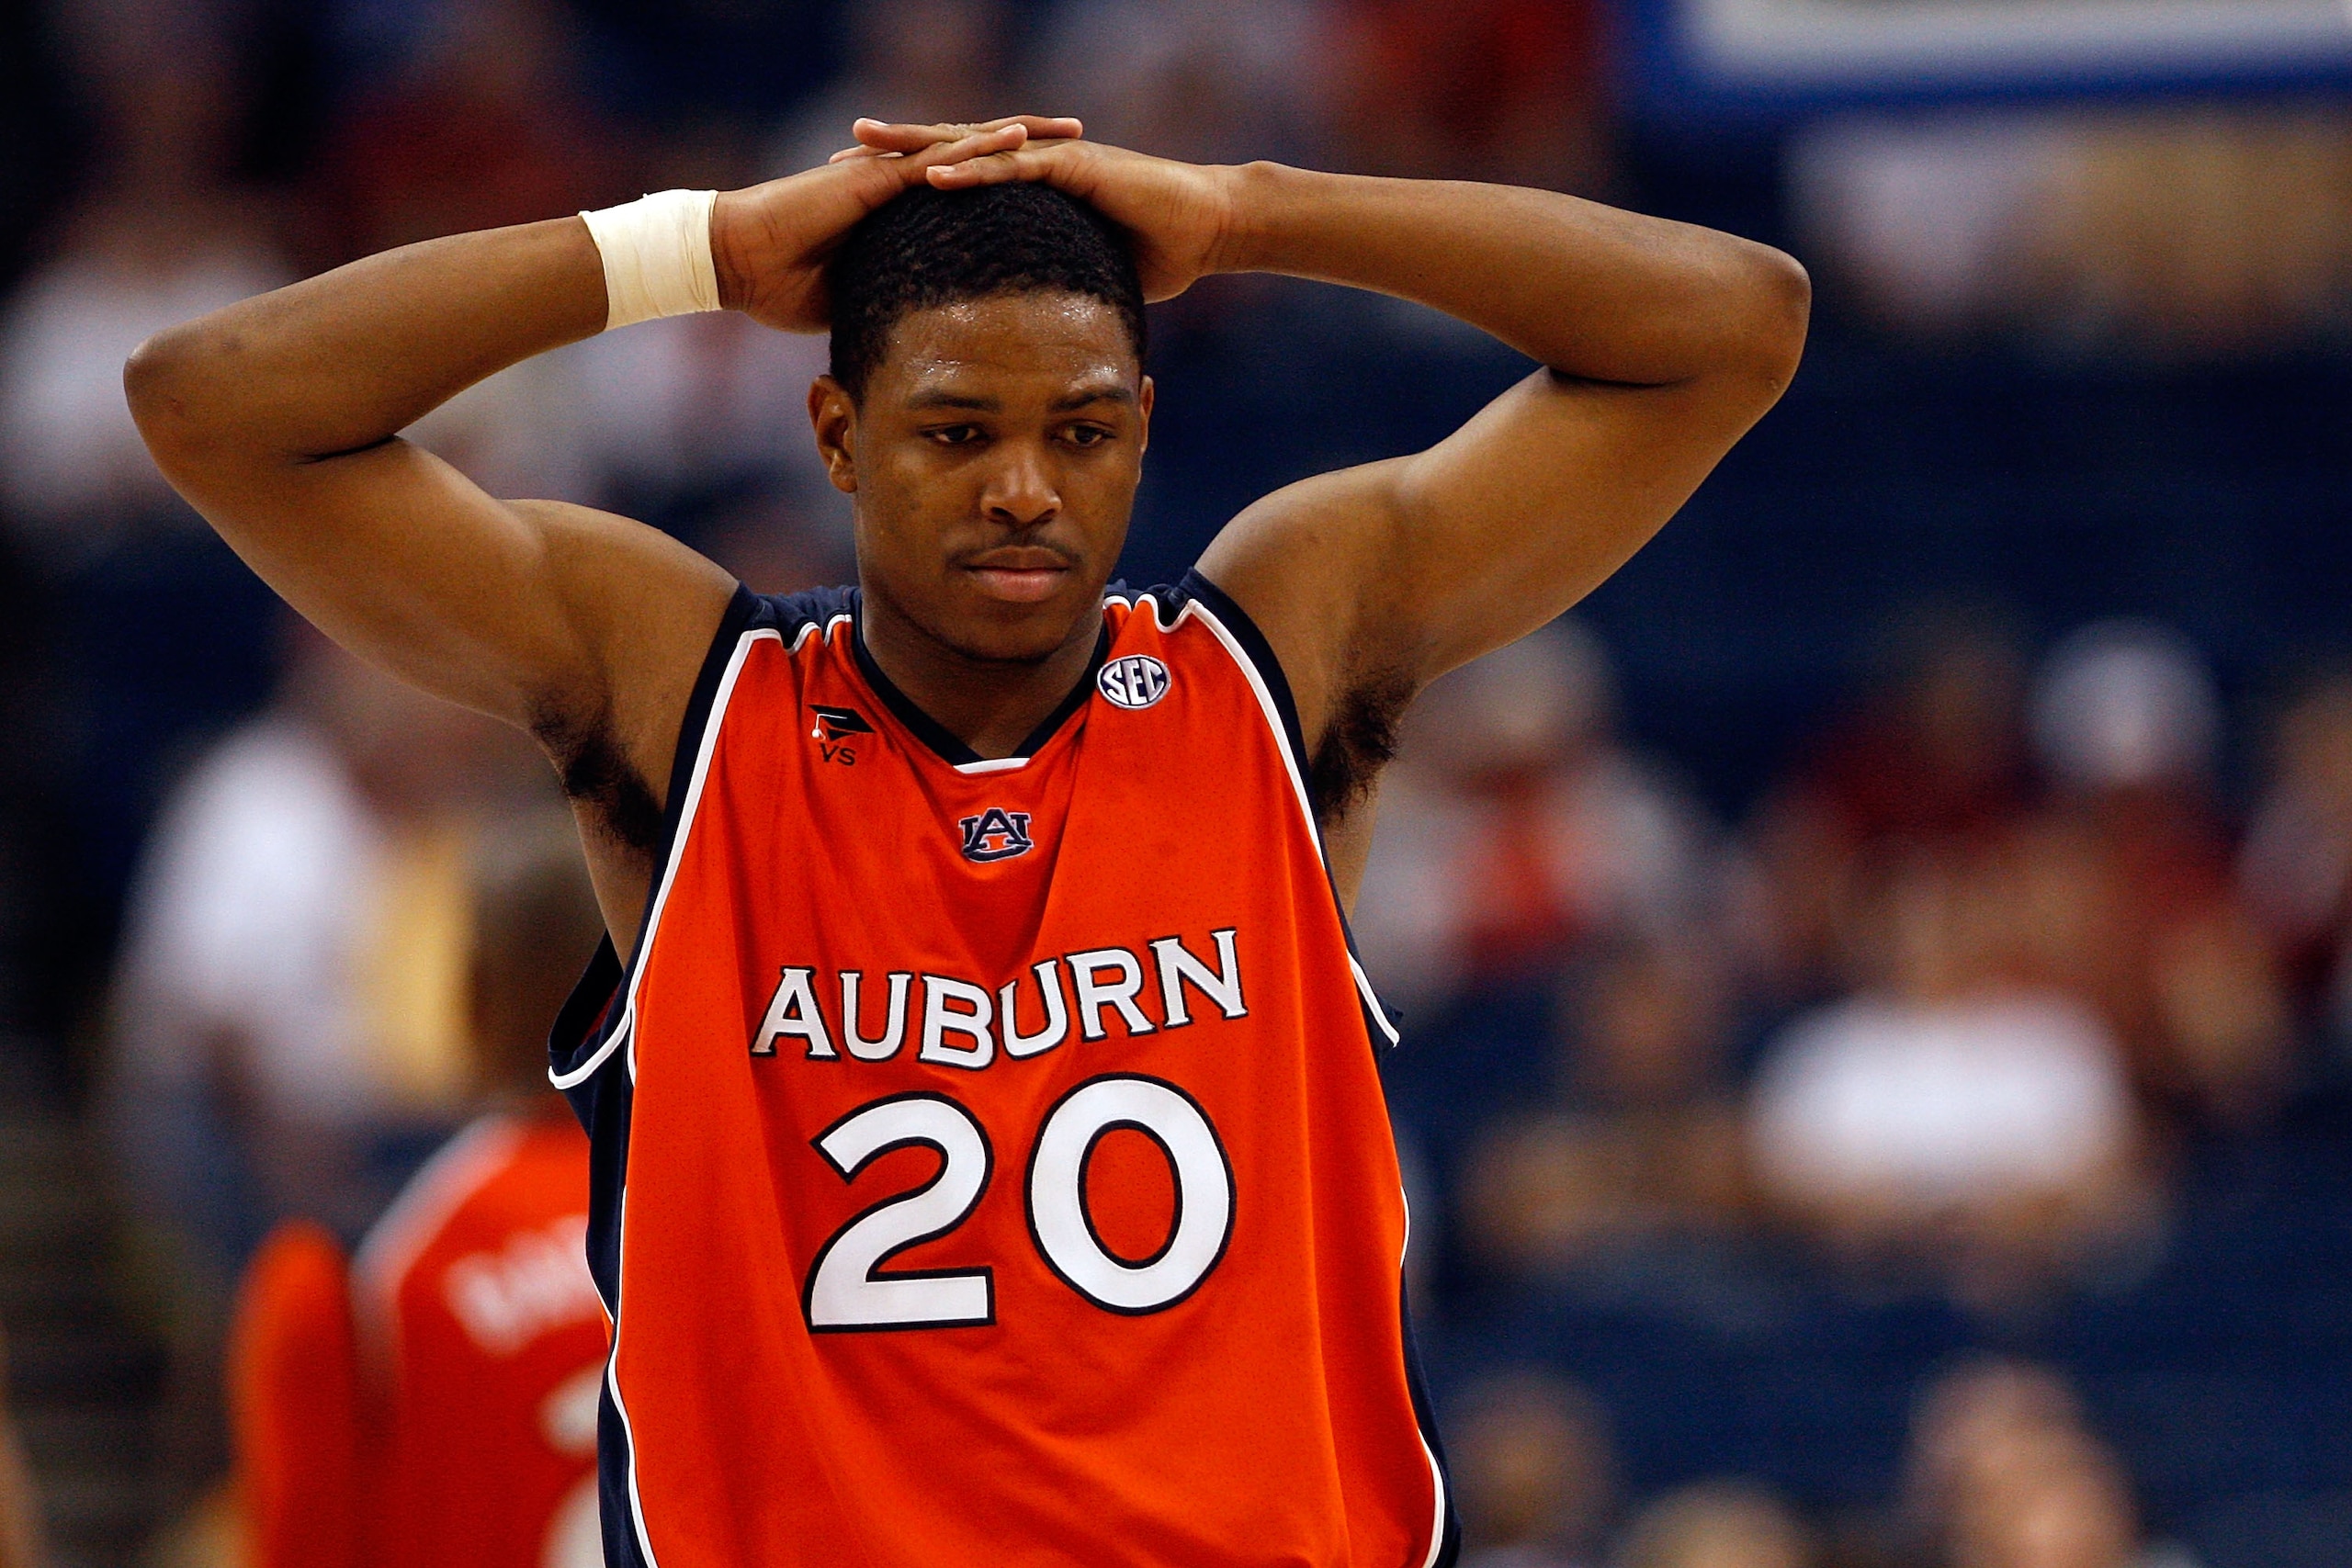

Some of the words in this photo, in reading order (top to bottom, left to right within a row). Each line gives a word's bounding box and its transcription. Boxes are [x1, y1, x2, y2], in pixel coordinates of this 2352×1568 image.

[1102, 657, 1165, 705] SEC
[751, 927, 1249, 1070] AUBURN
[802, 1072, 1238, 1334] 20
